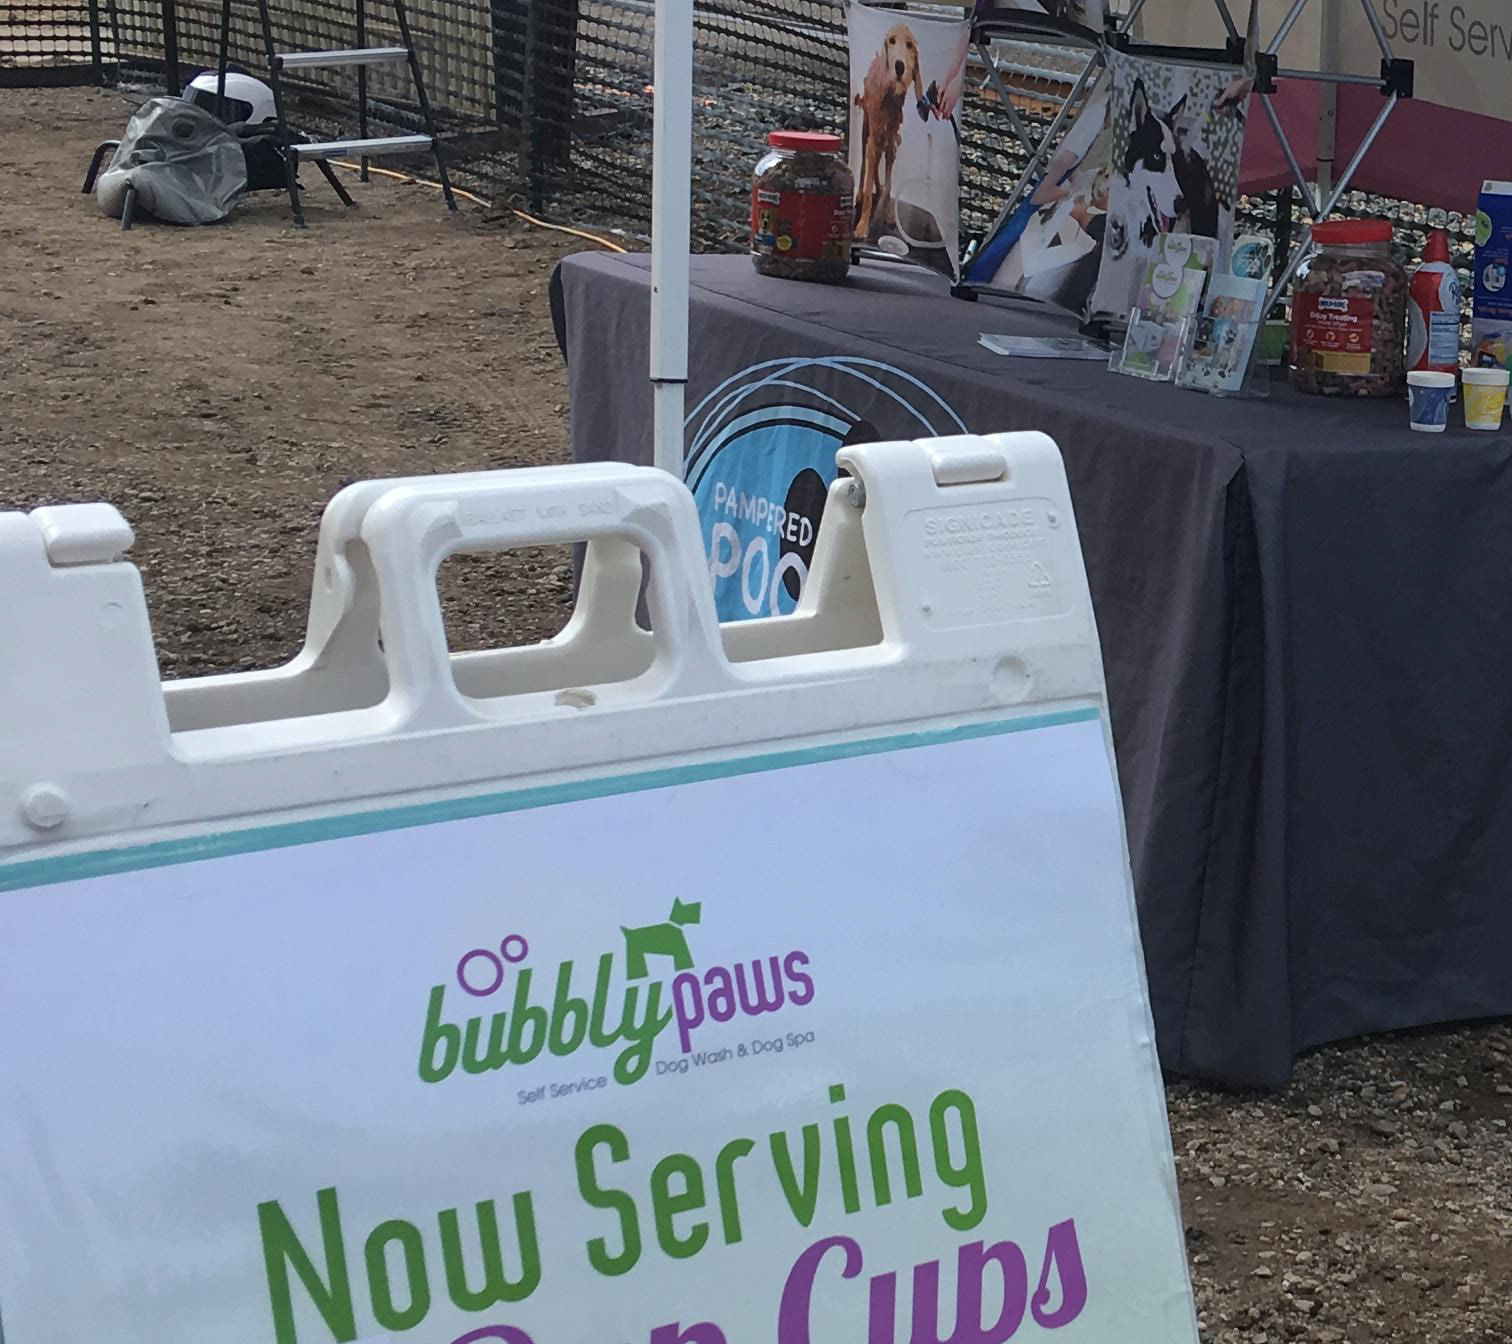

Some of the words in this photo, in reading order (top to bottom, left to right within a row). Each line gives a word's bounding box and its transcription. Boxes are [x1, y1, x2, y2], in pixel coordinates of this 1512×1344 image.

[714, 481, 813, 547] PAMPERED
[516, 1088, 546, 1106] Self
[549, 1075, 608, 1100] Service
[655, 1059, 689, 1077] Dog
[691, 1045, 733, 1069] Wash
[737, 1043, 749, 1058] &
[752, 1037, 784, 1055] Dog
[786, 1030, 815, 1051] Spa
[573, 1084, 989, 1277] Serving
